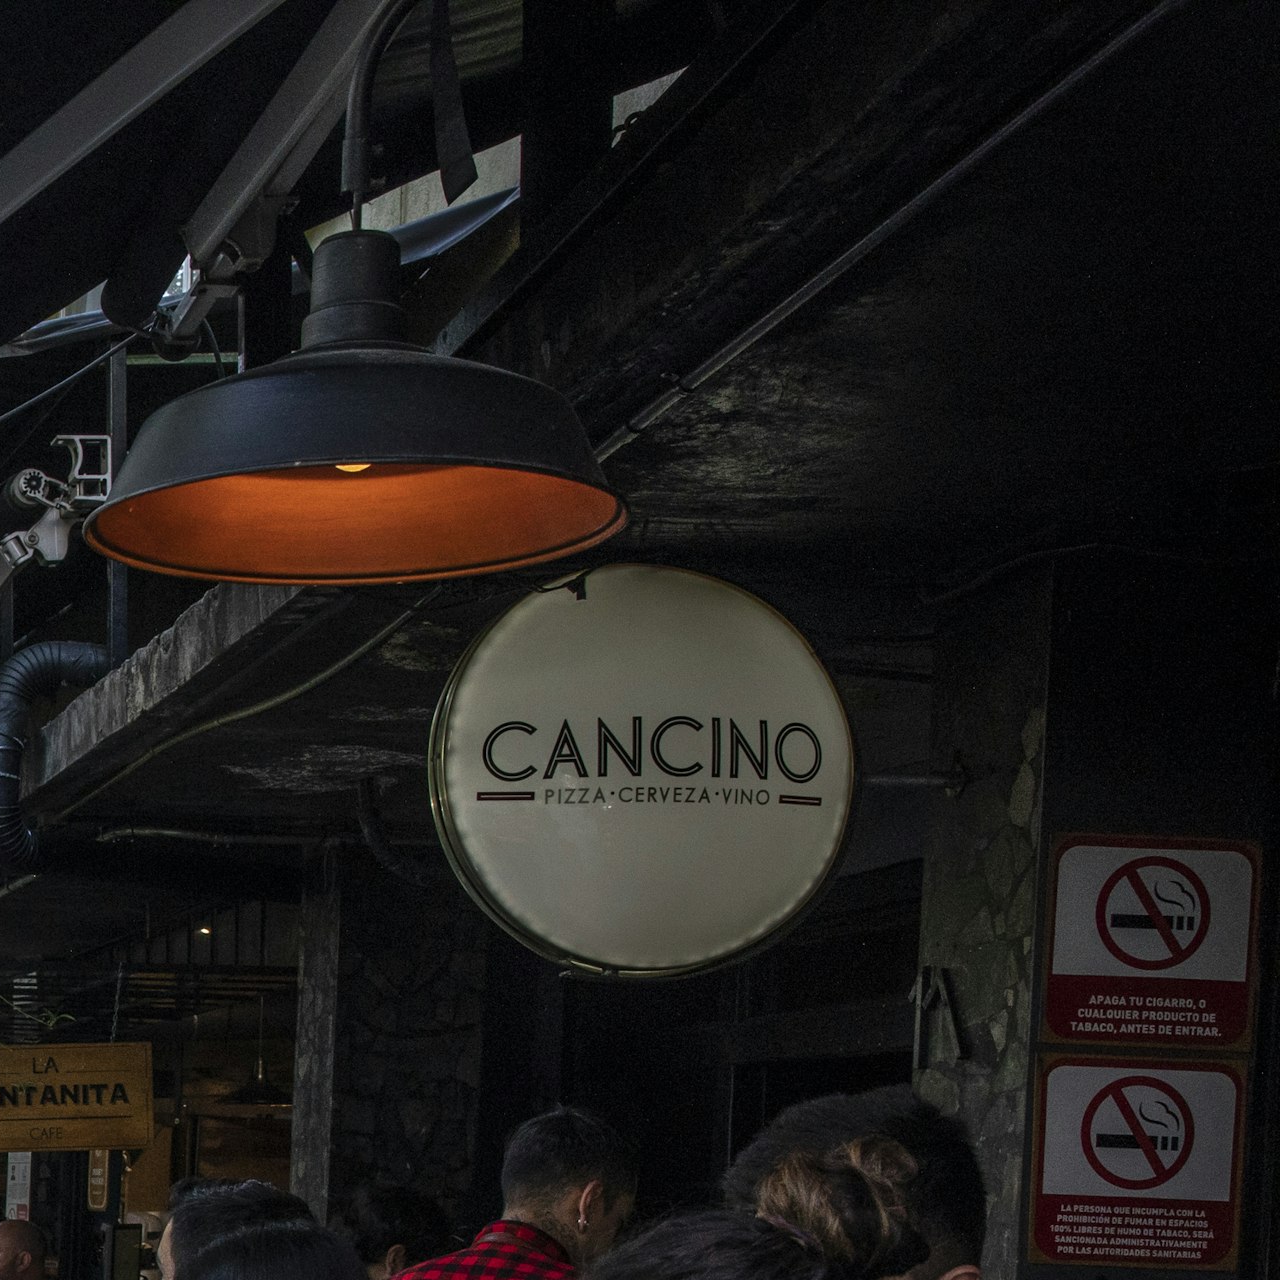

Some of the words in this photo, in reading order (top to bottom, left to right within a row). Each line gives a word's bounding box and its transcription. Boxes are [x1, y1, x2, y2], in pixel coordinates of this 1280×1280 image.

[482, 716, 822, 784] CANCINO
[544, 788, 606, 806] PIZZA
[618, 786, 711, 804] CERVEZA
[723, 789, 771, 806] VINO
[1089, 995, 1126, 1006] APAGA
[1129, 996, 1143, 1006] TU
[1146, 997, 1197, 1009] CIGARRO,
[1198, 999, 1207, 1009] O
[1078, 1008, 1140, 1020] CUALQUIER
[1142, 1010, 1200, 1023] PRODUCTO
[1201, 1013, 1216, 1023] DE
[1070, 1021, 1117, 1034] TABACO,
[1119, 1024, 1156, 1035] ANTES
[1158, 1025, 1173, 1035] DE
[1175, 1026, 1222, 1037] ENTRAR.
[32, 1056, 60, 1074] LA
[29, 1127, 63, 1140] CAFE
[1060, 1204, 1072, 1212] LA
[1074, 1205, 1112, 1214] PERSONA
[1114, 1206, 1130, 1215] QUE
[1132, 1207, 1175, 1217] INCUMPLA
[1176, 1208, 1193, 1217] CON
[1195, 1209, 1206, 1217] LA
[1056, 1213, 1110, 1225] PROHIBICIÓN
[1112, 1216, 1123, 1225] DE
[1125, 1216, 1153, 1226] FUMAR
[1155, 1218, 1167, 1226] EN
[1168, 1218, 1208, 1228] ESPACIOS
[1050, 1224, 1072, 1233] 100%
[1073, 1225, 1103, 1234] LIBRES
[1105, 1226, 1115, 1235] DE
[1117, 1227, 1141, 1236] HUMO
[1143, 1228, 1154, 1236] DE
[1192, 1227, 1214, 1239] SERÁ
[1054, 1235, 1108, 1246] SANCIONADA
[1110, 1237, 1208, 1249] ADMINISTRATIVAMENTE
[1057, 1245, 1074, 1254] POR
[1076, 1246, 1092, 1255] LAS
[1093, 1247, 1151, 1258] AUTORIDADES
[1152, 1249, 1202, 1259] SANITARIAS
